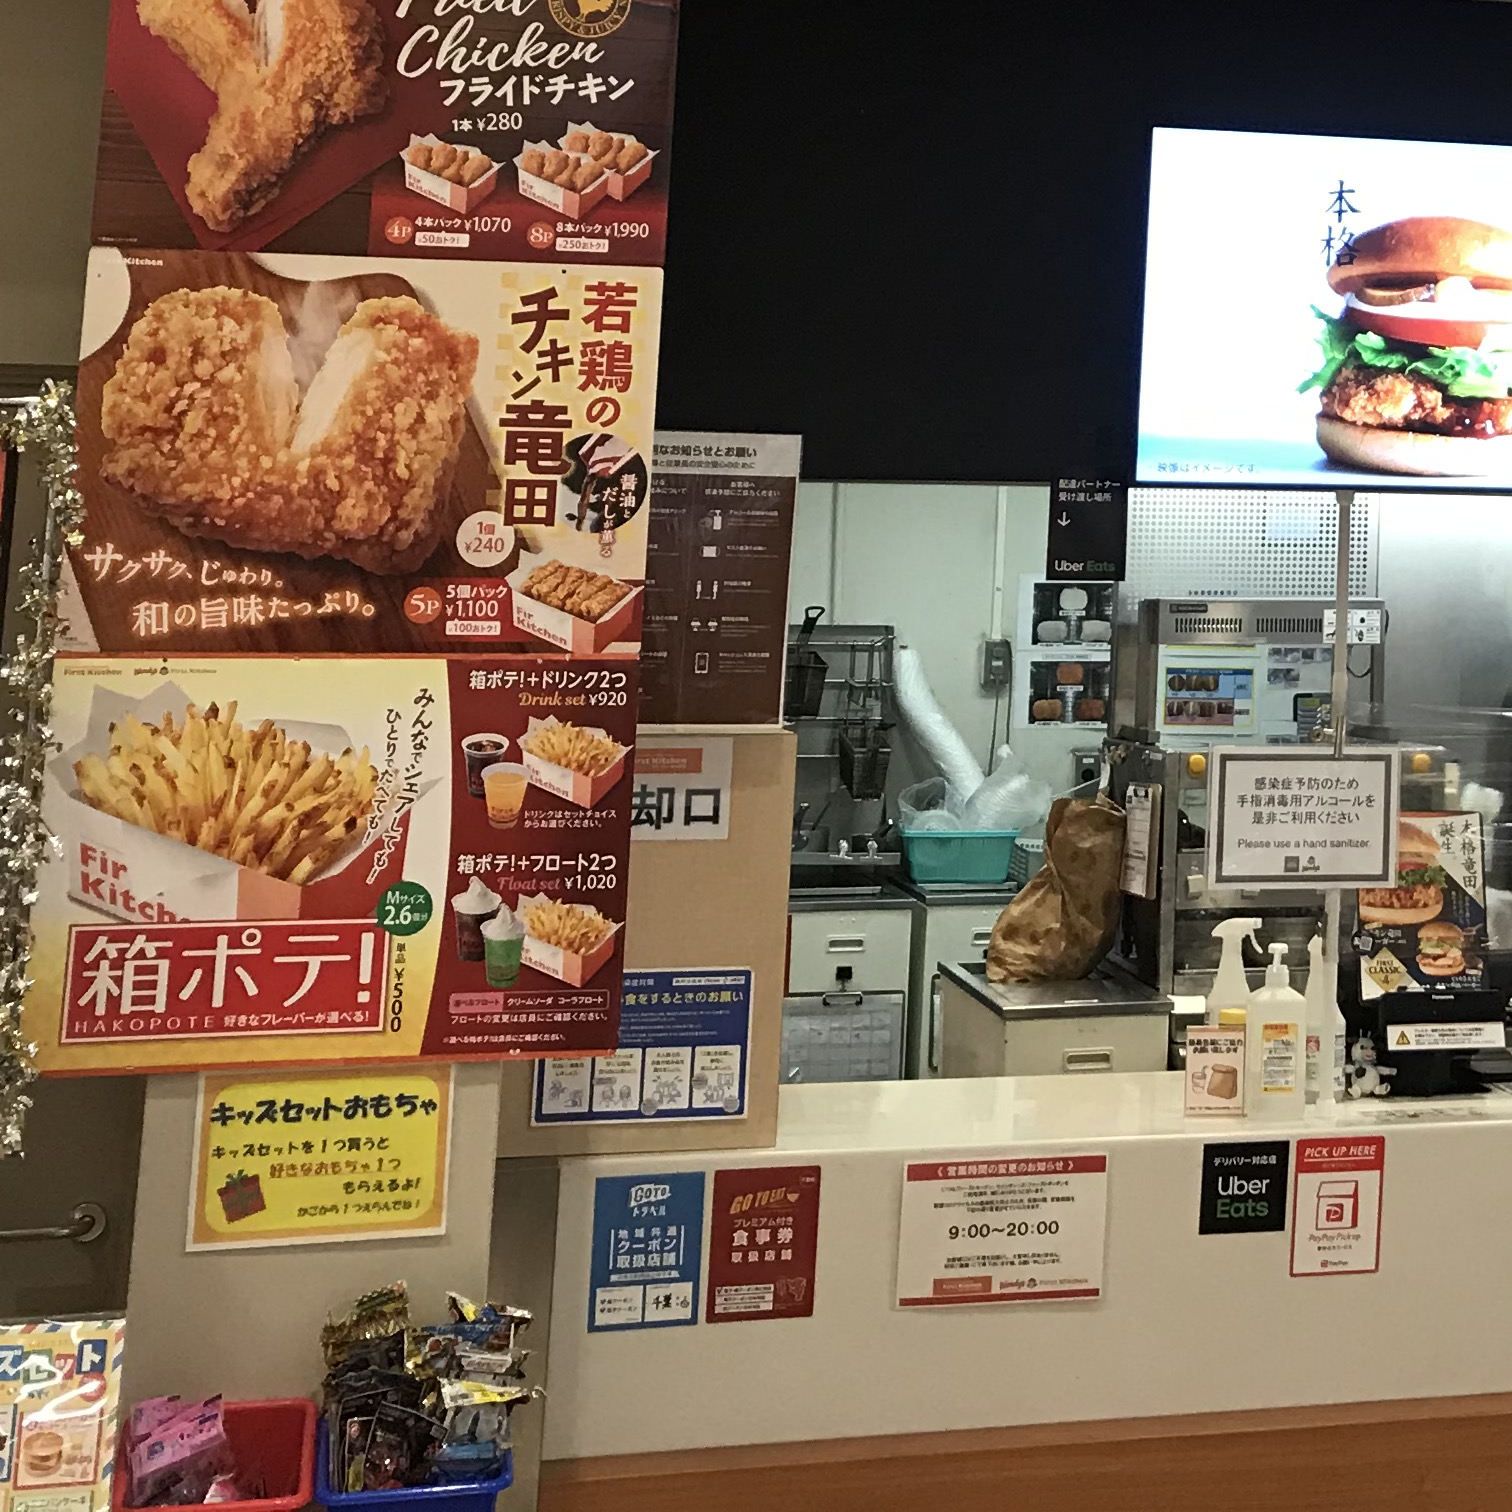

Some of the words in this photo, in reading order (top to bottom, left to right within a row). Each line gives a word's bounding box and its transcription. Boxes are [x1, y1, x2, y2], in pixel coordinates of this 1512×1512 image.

[396, 14, 604, 78] Chicken
[440, 72, 635, 107] フライドチキン
[451, 118, 472, 133] 1本
[476, 112, 523, 131] ¥280
[386, 220, 412, 240] 4P
[414, 216, 462, 230] 4本パック
[464, 216, 512, 234] ¥1,070
[555, 221, 602, 235] 8本パック
[604, 222, 650, 239] ¥1,990
[1320, 179, 1361, 268] 本格
[529, 227, 554, 244] 8P
[125, 257, 164, 267] Kitchen
[578, 281, 638, 429] 若鶏の
[498, 286, 575, 528] チキン竜田
[1058, 478, 1121, 489] 配達パートナー
[619, 473, 638, 519] 醤油と
[1058, 492, 1113, 503] 受け渡し場所
[477, 521, 496, 536] 1個
[464, 536, 505, 554] ¥240
[83, 542, 284, 588] サクサク、じゅわり。
[1054, 559, 1085, 572] Uber
[1086, 560, 1116, 572] Eats
[446, 585, 508, 600] 5個パック
[132, 590, 376, 638] 和の旨味たっぷり。
[408, 595, 441, 616] 5P
[445, 599, 499, 619] ¥1,100
[515, 615, 569, 647] Kitchen
[518, 691, 562, 707] Drink
[564, 693, 587, 706] set
[588, 691, 628, 707] ¥920
[1254, 776, 1360, 791] 感染症予防のため
[1236, 793, 1376, 809] 手指消毒用アルコールを
[1251, 810, 1360, 825] 是非ご利用ください
[1237, 838, 1271, 850] Please
[1273, 840, 1292, 849] use
[1302, 838, 1328, 849] hand
[79, 842, 129, 880] Fir
[496, 875, 536, 892] Float
[538, 875, 562, 891] set
[564, 874, 617, 891] ¥1,020
[385, 890, 426, 905] Mサイズ
[77, 926, 375, 1016] 箱ポテ!
[390, 968, 404, 1033] ¥500
[507, 996, 554, 1007] クリームソーダ
[557, 995, 604, 1005] コーラフロート
[75, 1014, 215, 1033] HAKOPOTE
[210, 1092, 438, 1126] キッズセットおもちゃ
[1304, 1146, 1329, 1157] PICK
[1331, 1145, 1348, 1156] UP
[1348, 1144, 1377, 1156] HERE
[1213, 1155, 1278, 1167] デリバリー対応店
[1217, 1175, 1271, 1196] Uber
[632, 1205, 667, 1218] トラベル
[1216, 1198, 1269, 1219] Eats
[617, 1238, 677, 1254] クーポン
[732, 1227, 794, 1247] 食事券
